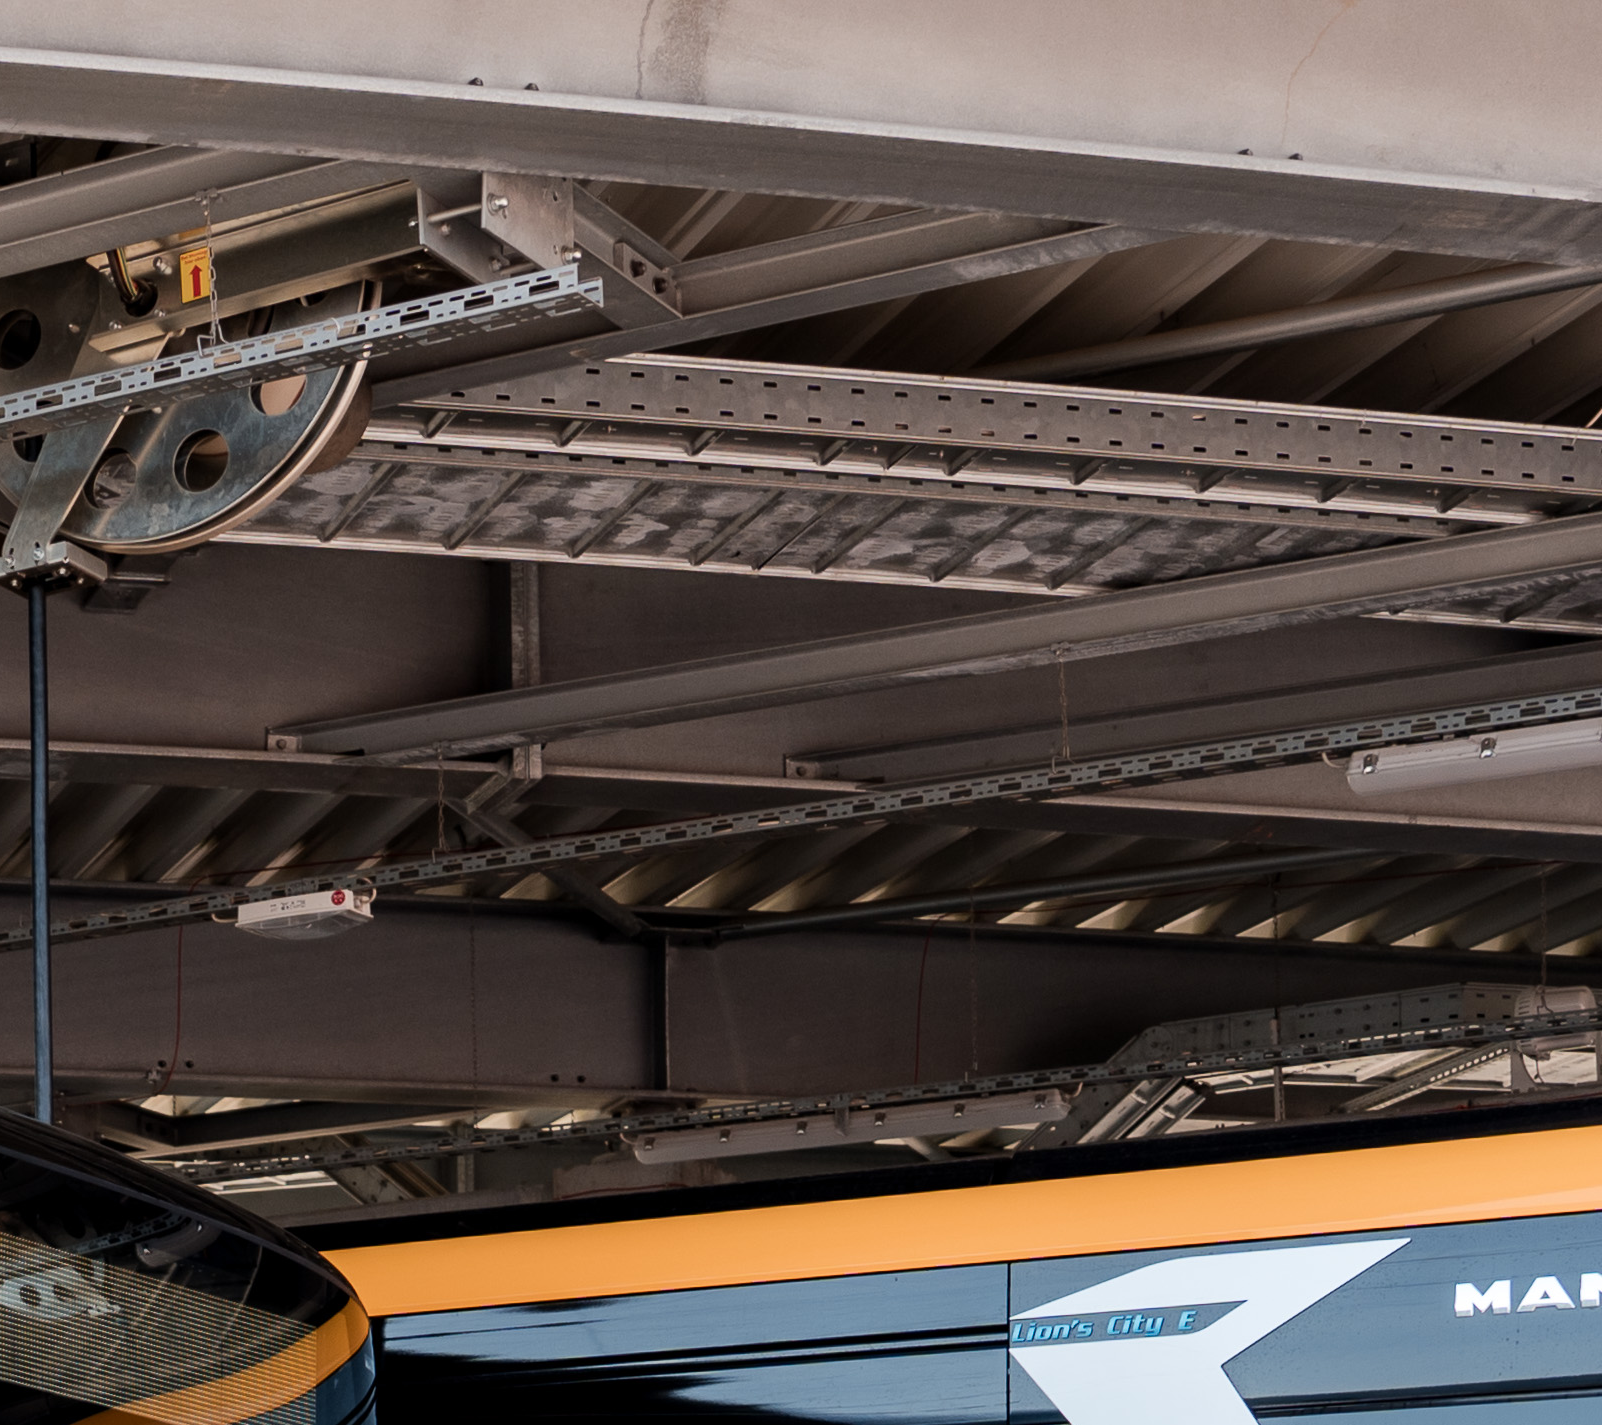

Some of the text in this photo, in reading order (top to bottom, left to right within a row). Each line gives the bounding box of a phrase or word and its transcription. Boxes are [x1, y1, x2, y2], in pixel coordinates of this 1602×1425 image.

[1011, 1310, 1197, 1343] Lion's City E
